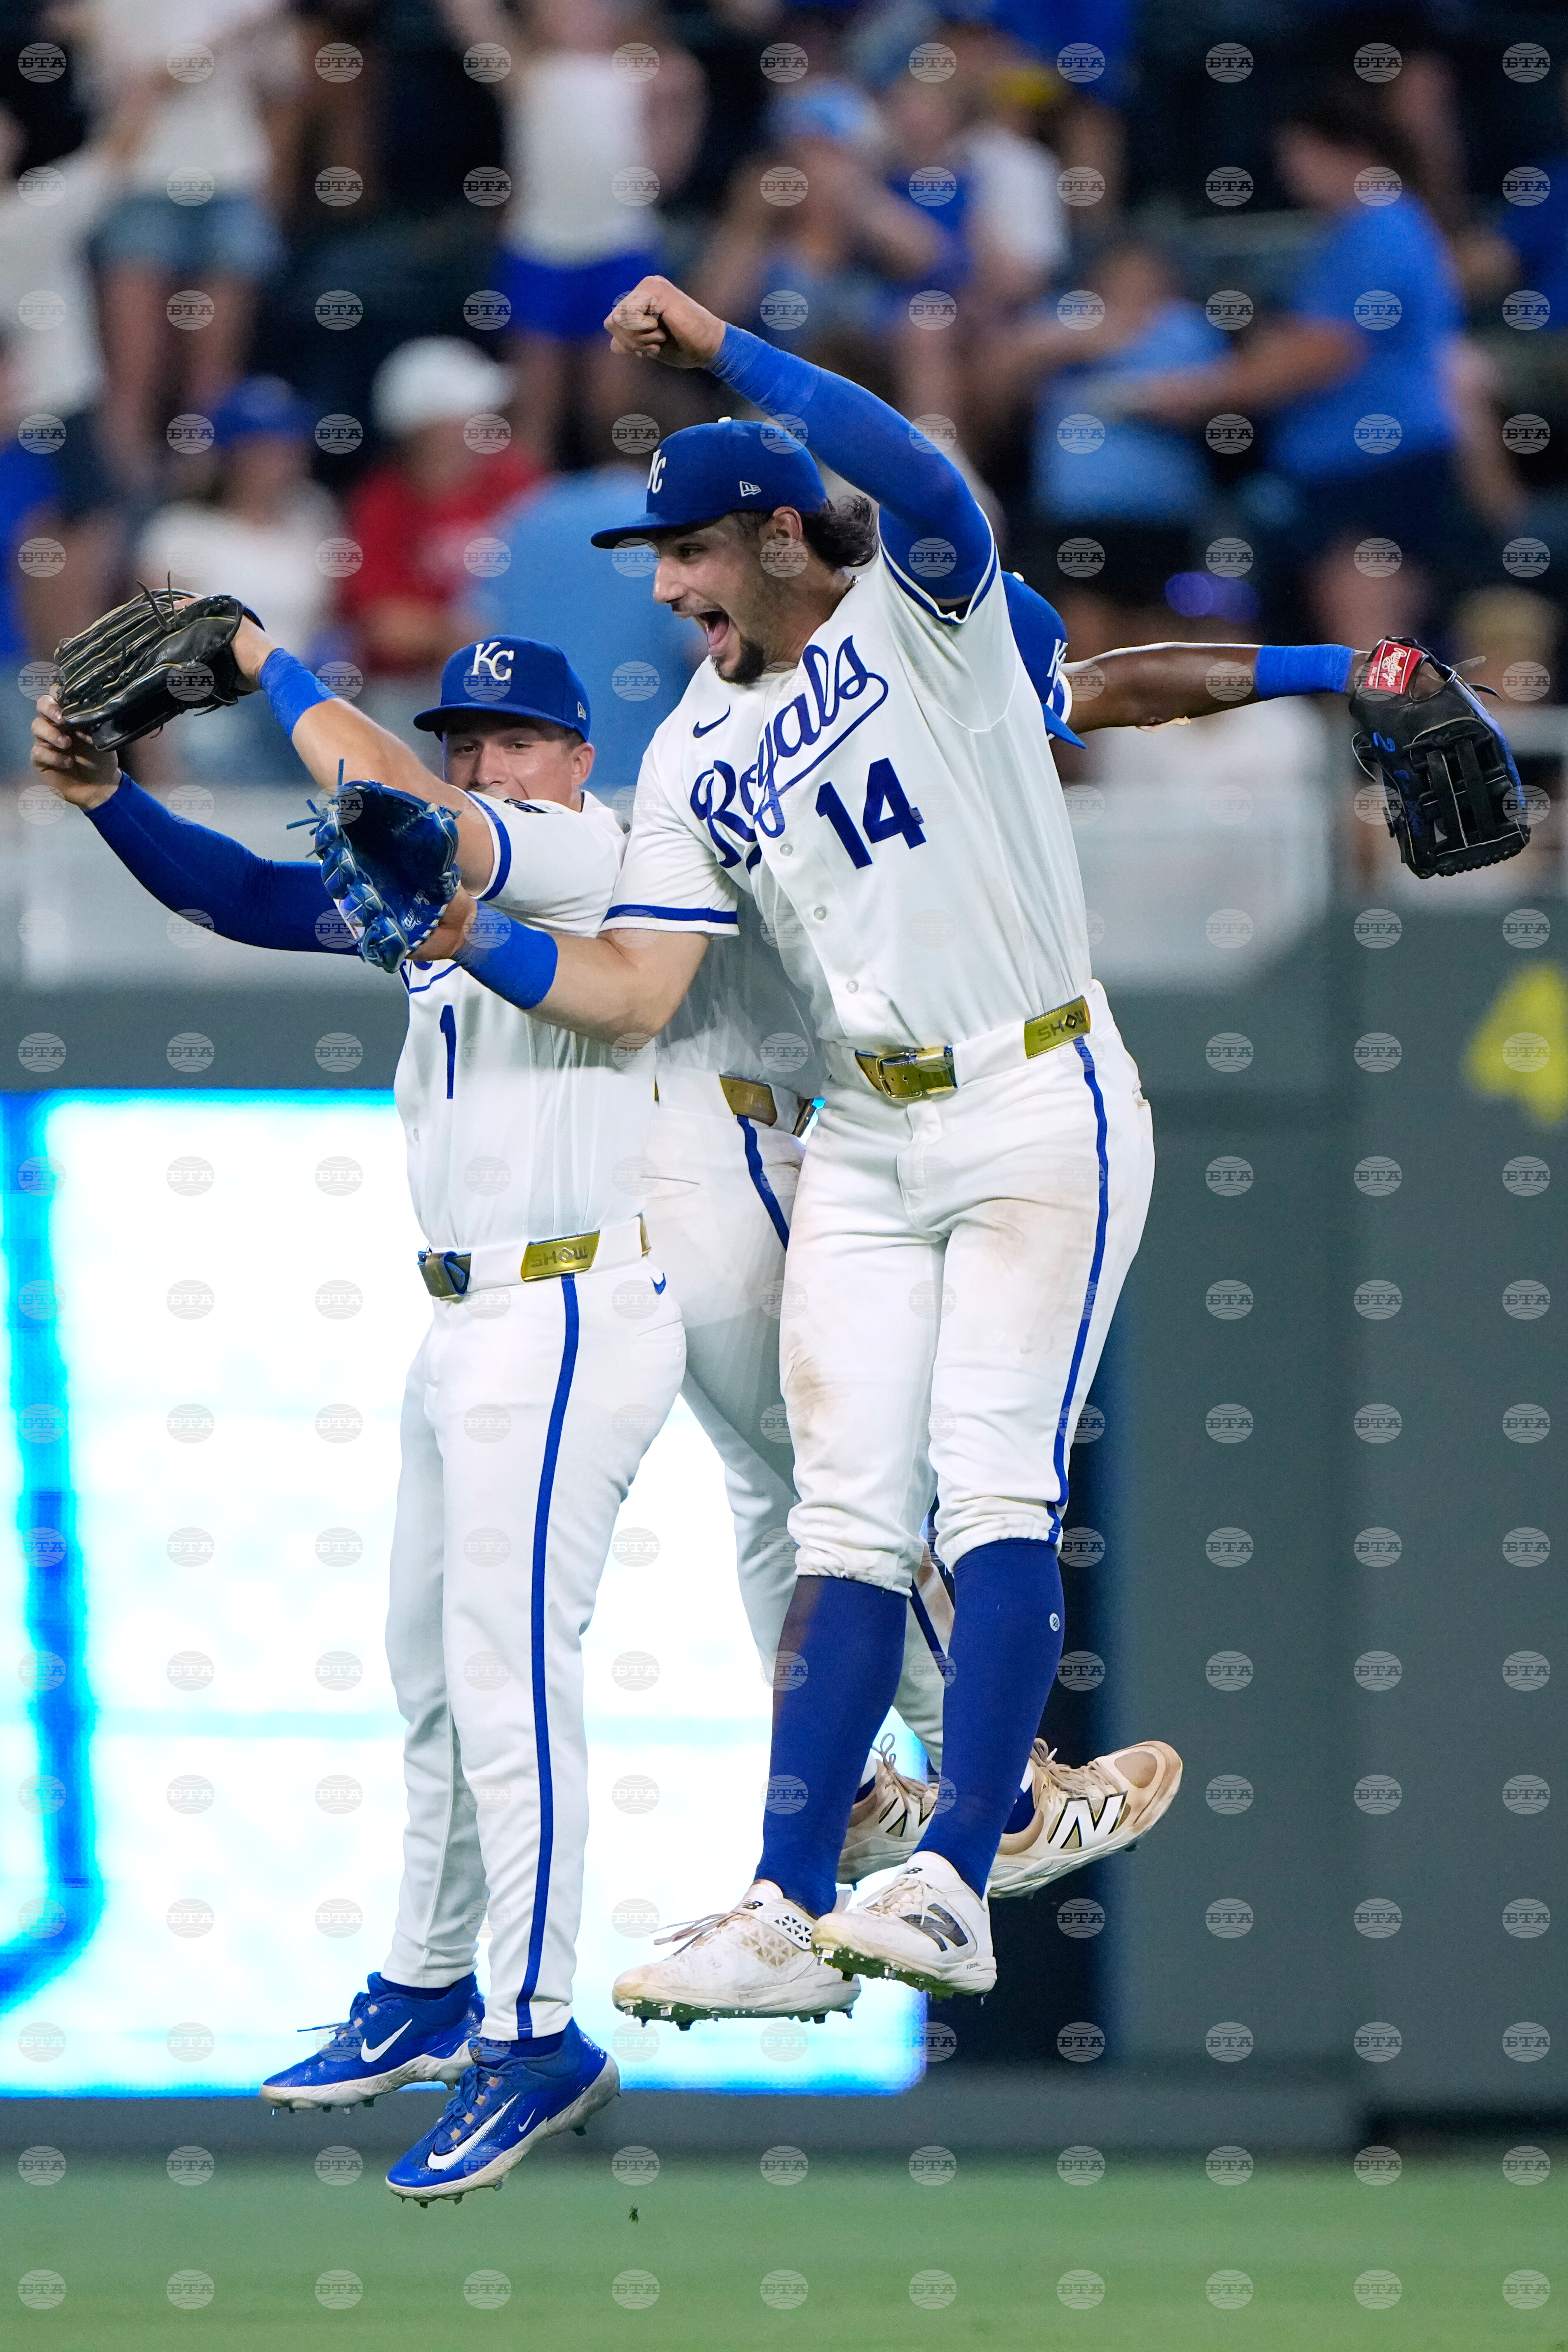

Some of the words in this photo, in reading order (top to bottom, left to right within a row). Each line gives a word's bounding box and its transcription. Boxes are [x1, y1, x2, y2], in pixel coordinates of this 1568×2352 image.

[471, 642, 514, 681] KC
[1382, 647, 1407, 687] Rawlings
[690, 635, 889, 868] Royals
[816, 757, 926, 870] 14
[440, 1005, 457, 1099] 1
[1037, 1007, 1087, 1042] SHOW
